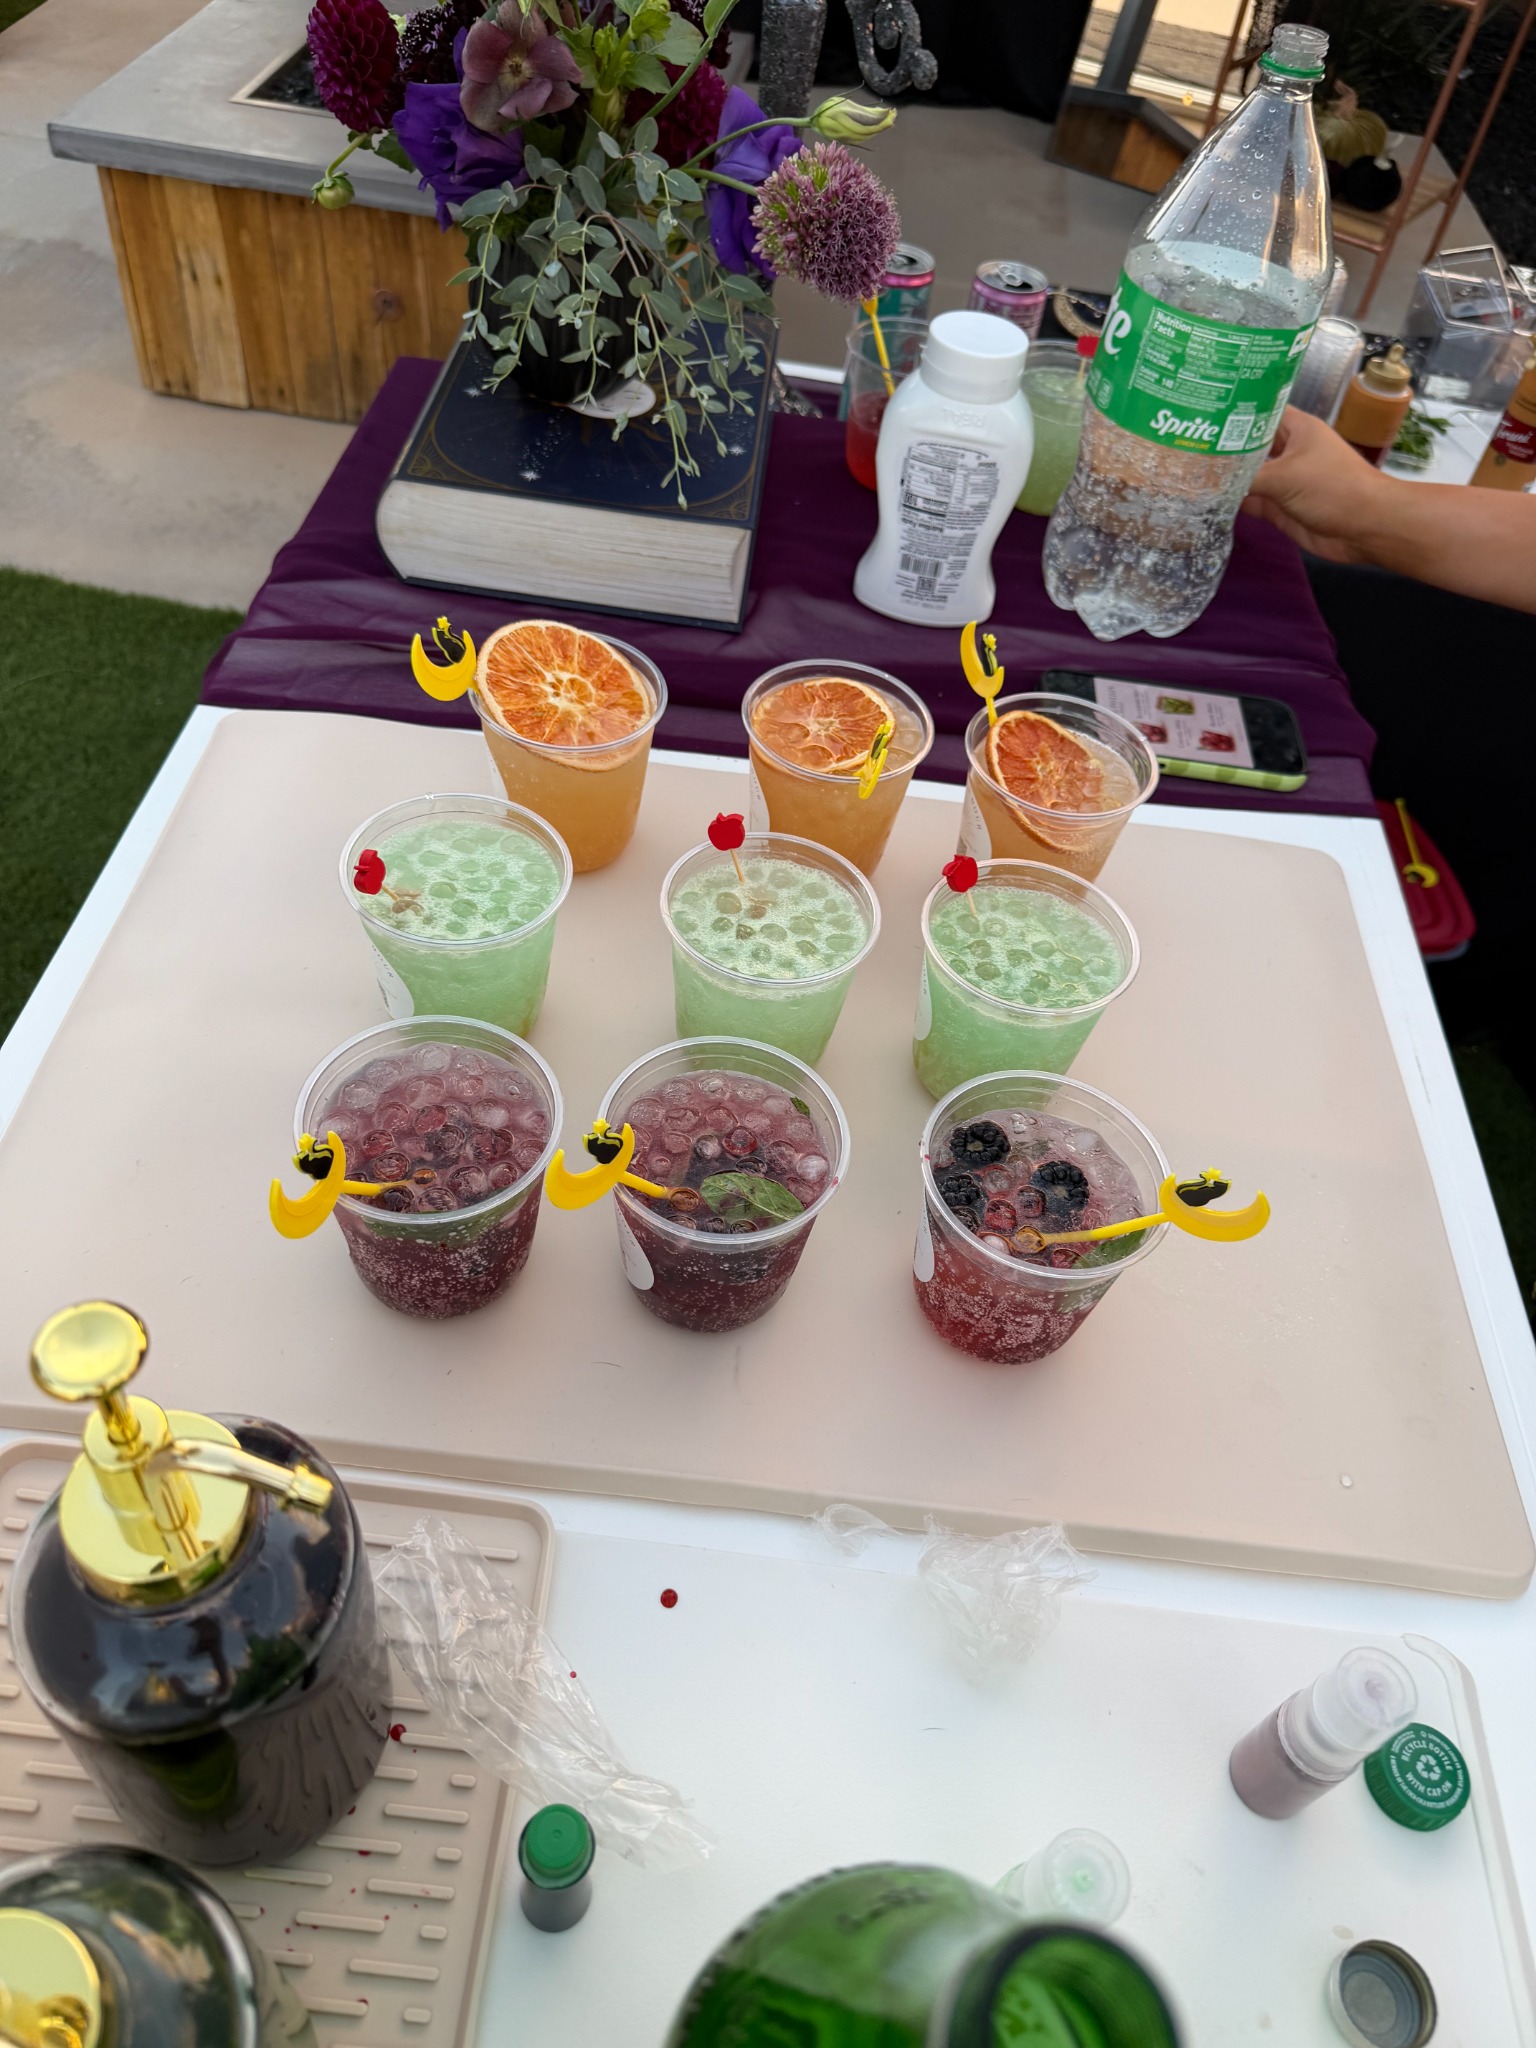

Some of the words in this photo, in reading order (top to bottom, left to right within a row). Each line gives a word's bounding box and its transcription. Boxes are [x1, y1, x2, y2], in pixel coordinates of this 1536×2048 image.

[1152, 320, 1176, 338] Facts
[1156, 311, 1192, 333] Nutrition
[1150, 409, 1220, 441] Sprite
[1401, 1740, 1427, 1762] RECYCLE
[1428, 1742, 1453, 1771] BOTTLE
[1405, 1772, 1425, 1793] WITH
[1427, 1788, 1442, 1796] CAP
[1442, 1781, 1452, 1793] ON
